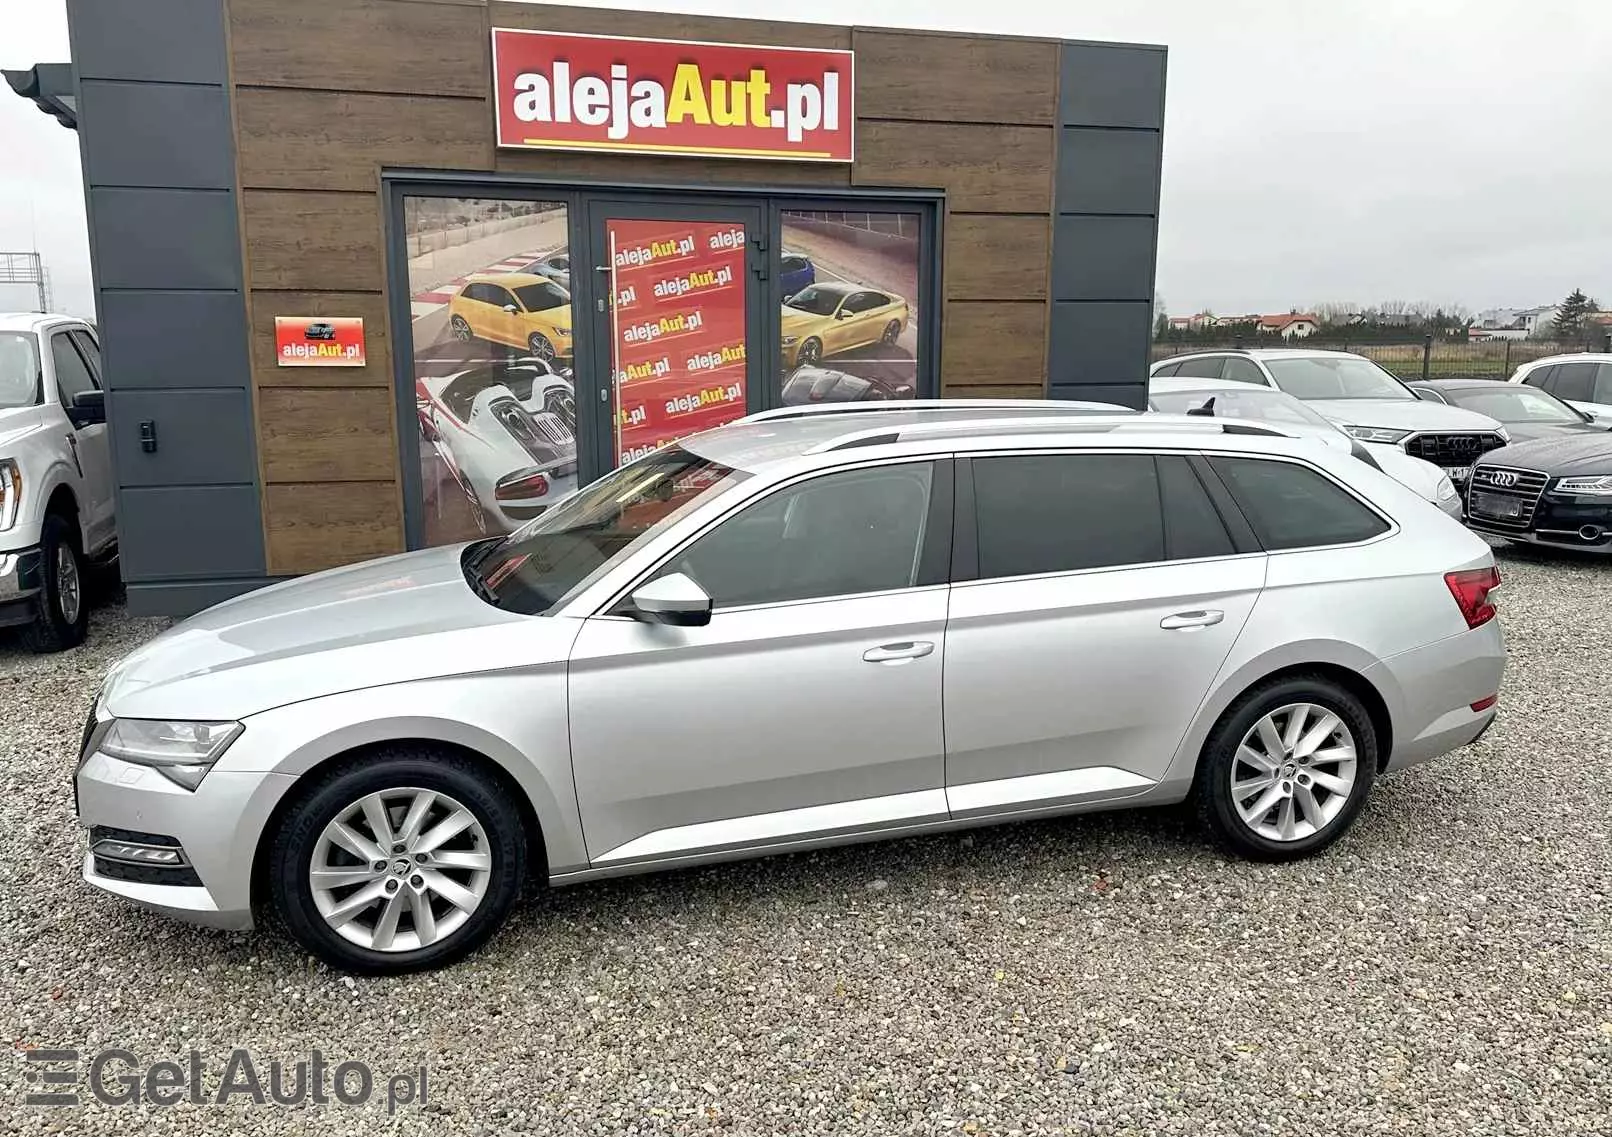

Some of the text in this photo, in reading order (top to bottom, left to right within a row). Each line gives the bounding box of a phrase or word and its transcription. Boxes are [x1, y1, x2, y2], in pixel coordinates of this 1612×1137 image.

[513, 61, 840, 142] alejaAut.pl
[615, 235, 695, 266] alejaAut.pl
[609, 286, 637, 306] .pl
[653, 266, 733, 297] alejaAut.pl
[623, 311, 703, 342] alejaAut.pl
[283, 343, 360, 359] alejaAut.pl
[665, 382, 742, 413] alejaAut.pl
